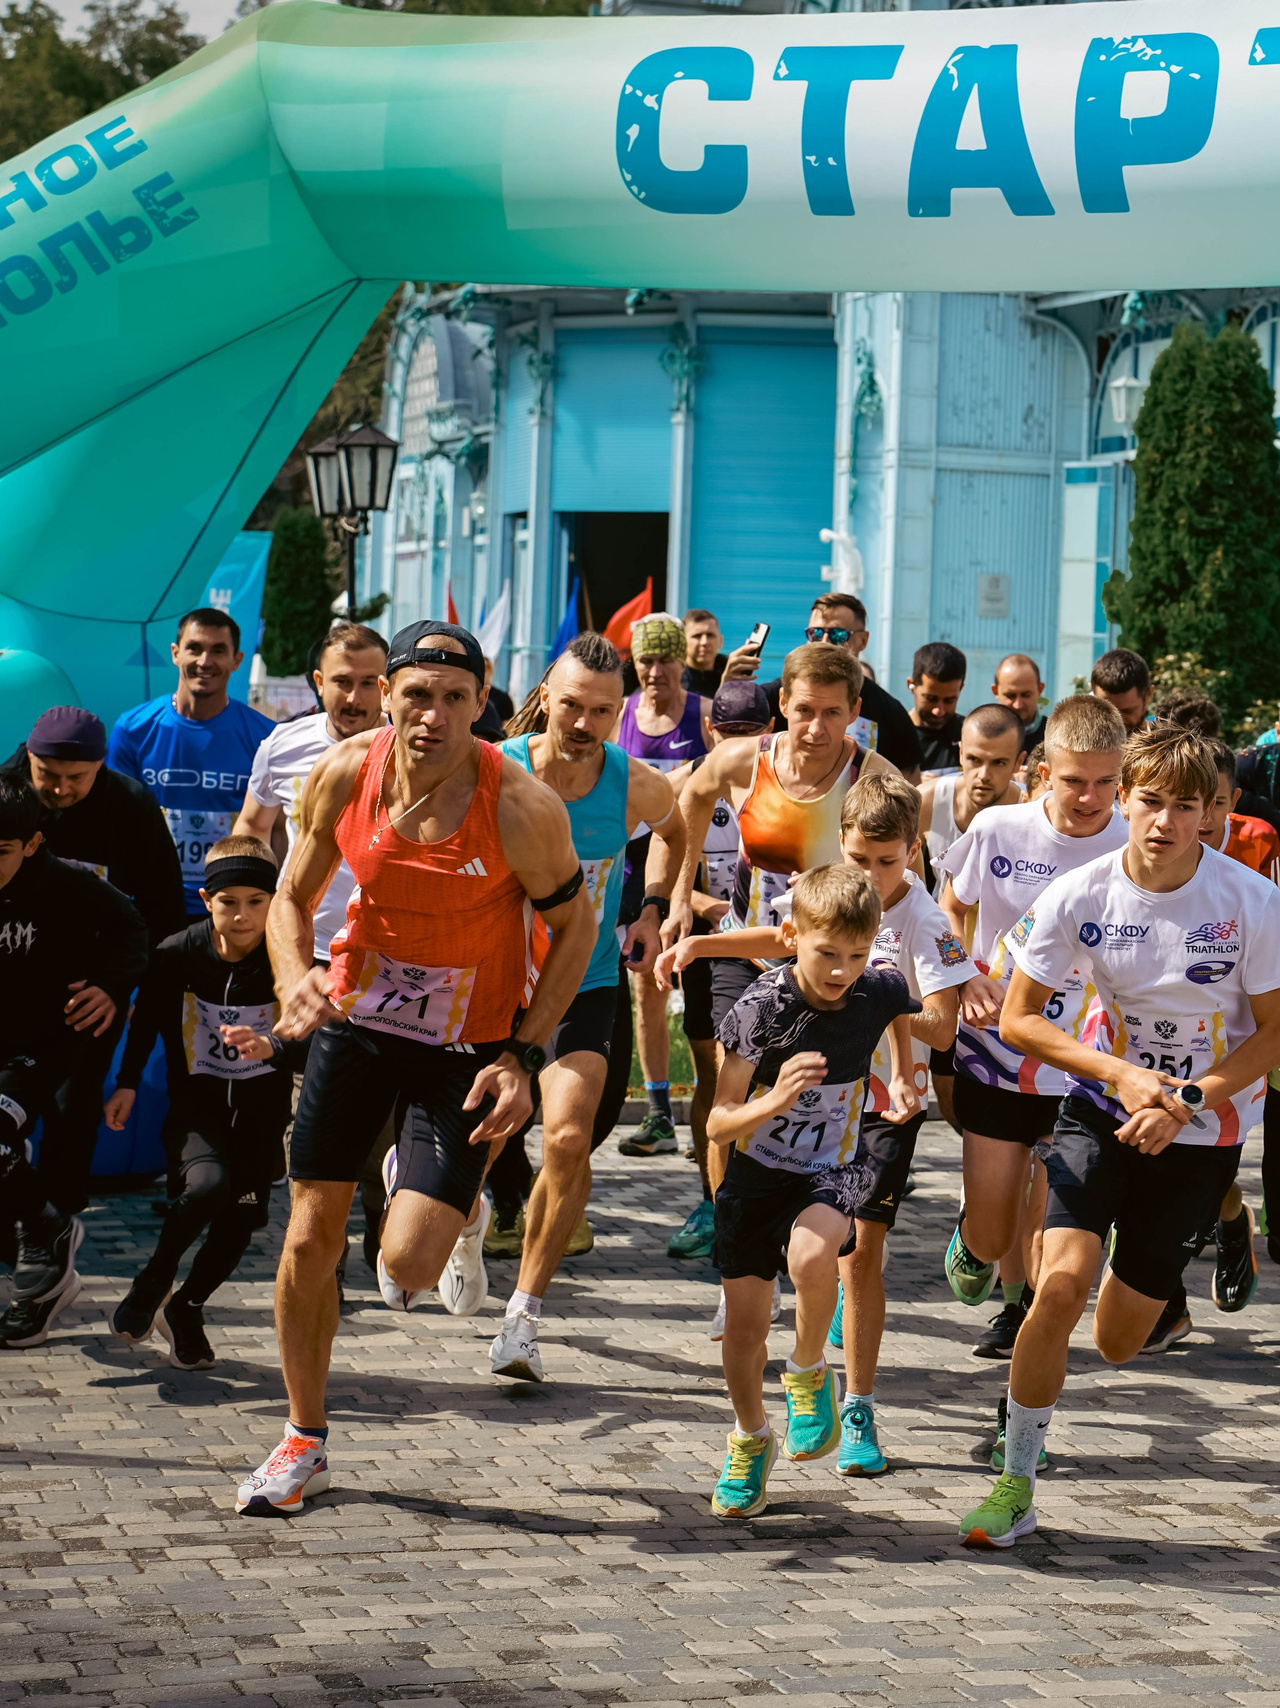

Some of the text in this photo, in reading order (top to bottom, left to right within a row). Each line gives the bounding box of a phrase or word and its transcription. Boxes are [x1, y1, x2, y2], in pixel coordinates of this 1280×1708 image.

[0, 171, 200, 328] ОЛЬЕ
[1015, 859, 1057, 876] СКФУ
[1104, 923, 1150, 938] СКФУ
[1185, 945, 1239, 954] TRIATHLON
[376, 989, 430, 1019] 171
[418, 1027, 438, 1038] КРАЙ
[768, 1115, 827, 1152] 271
[755, 1143, 831, 1171] СТАВРОПОЛЬСКИЙ КРАЙ
